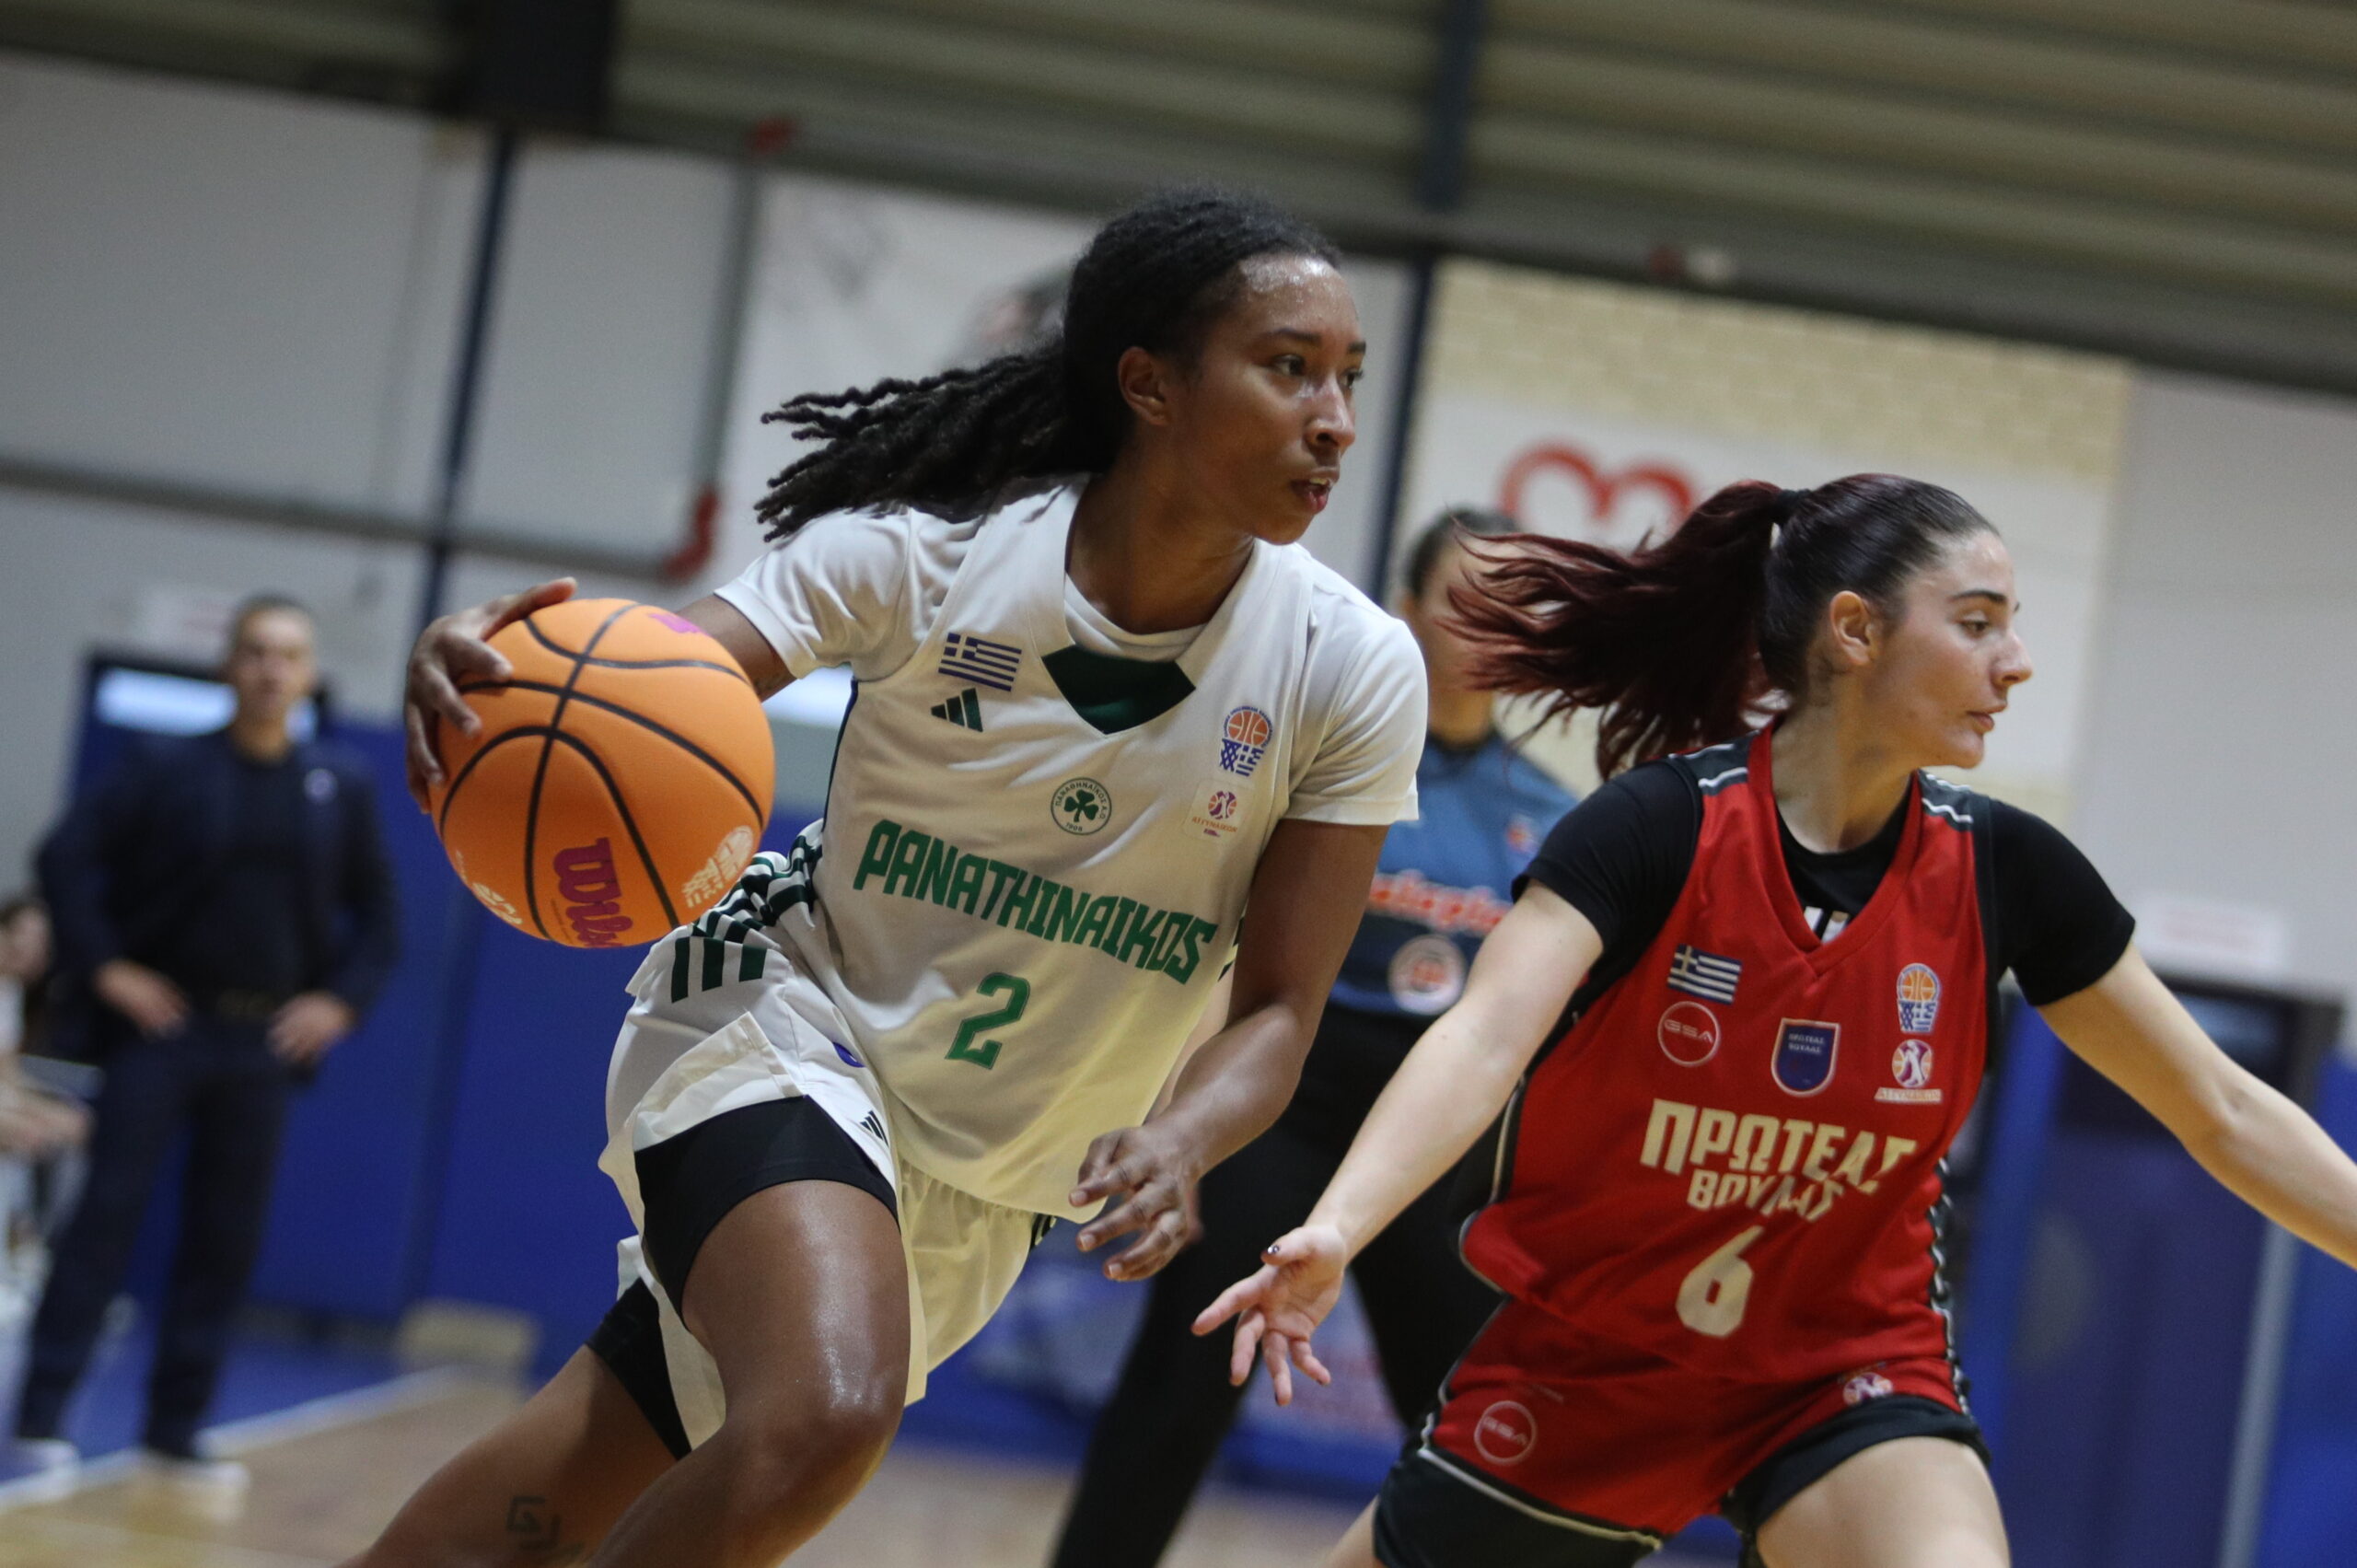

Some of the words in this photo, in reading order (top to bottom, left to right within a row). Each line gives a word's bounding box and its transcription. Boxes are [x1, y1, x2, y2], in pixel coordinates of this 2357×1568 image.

[853, 819, 1218, 985] PANATHINAIKOS
[945, 972, 1030, 1070] 2
[1640, 1098, 1918, 1195] ΠΡΩΤΕΑΣ
[1675, 1225, 1765, 1340] 6
